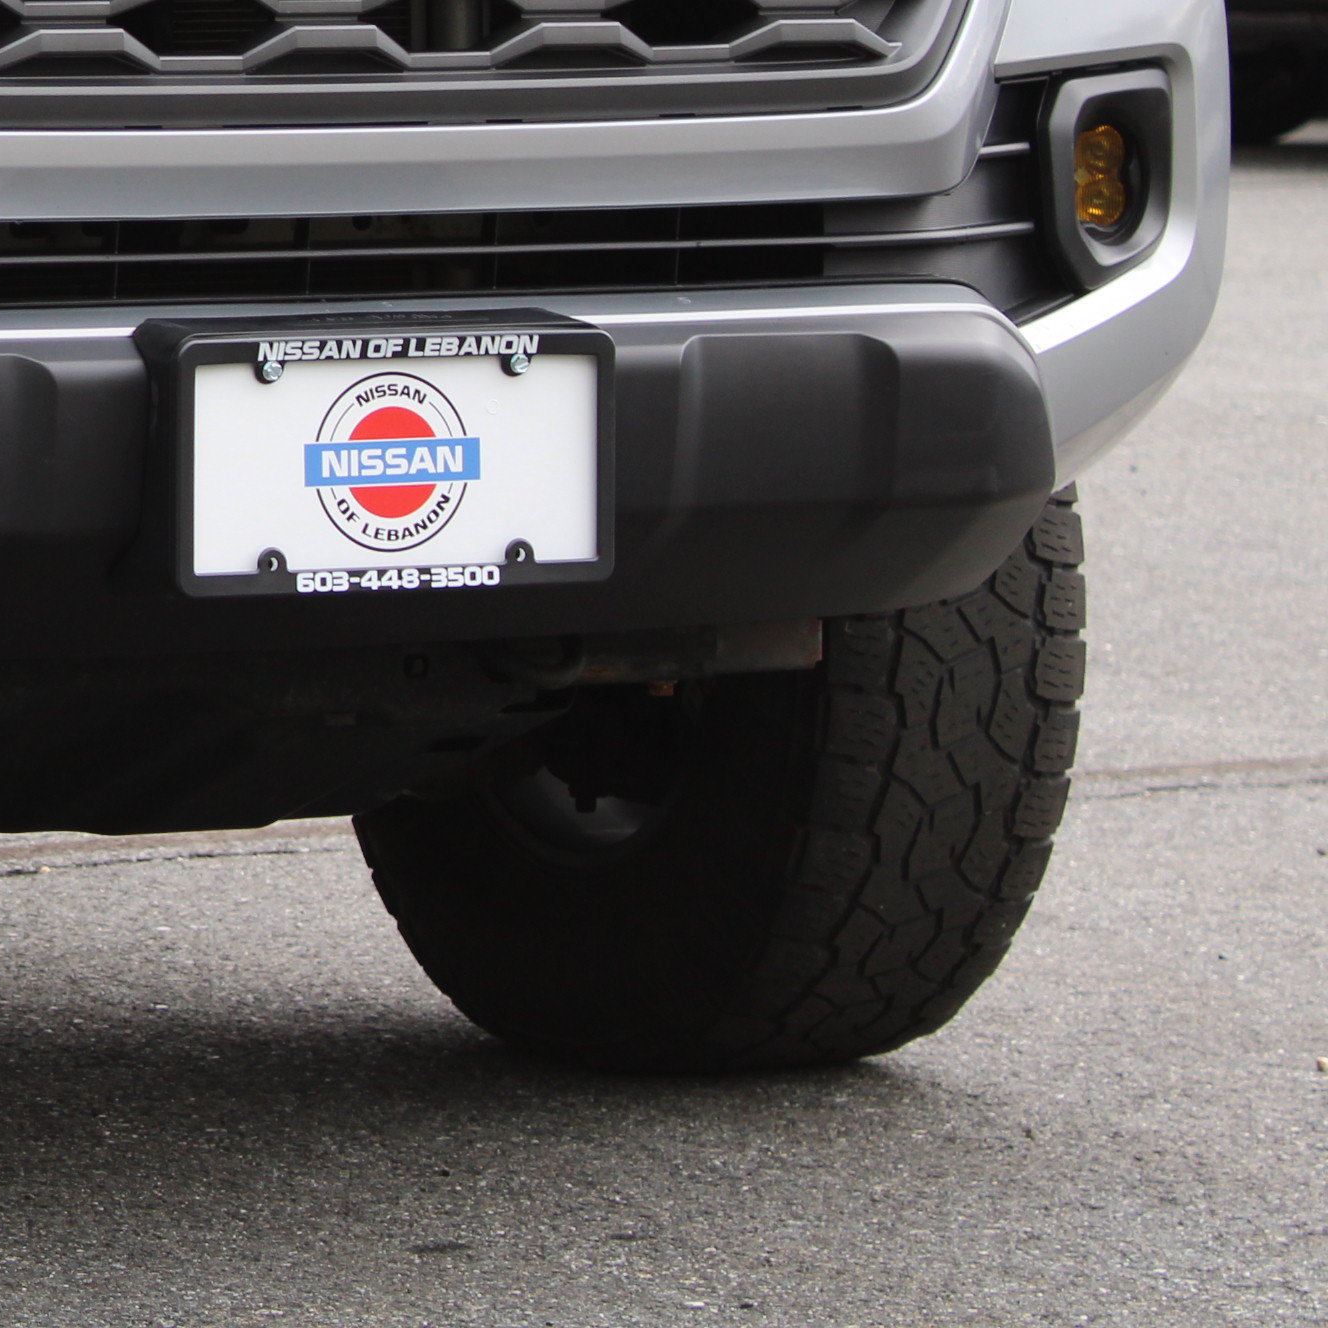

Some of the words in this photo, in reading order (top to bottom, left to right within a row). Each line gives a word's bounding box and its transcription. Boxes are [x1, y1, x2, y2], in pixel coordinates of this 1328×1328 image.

[258, 338, 361, 362] NISSAN
[367, 337, 404, 359] OF
[407, 334, 540, 358] LEBANON
[355, 383, 428, 407] NISSAN
[321, 444, 464, 478] NISSAN
[336, 497, 360, 525] OF
[362, 492, 451, 542] LEBANON
[296, 565, 501, 594] 603-448-3500
